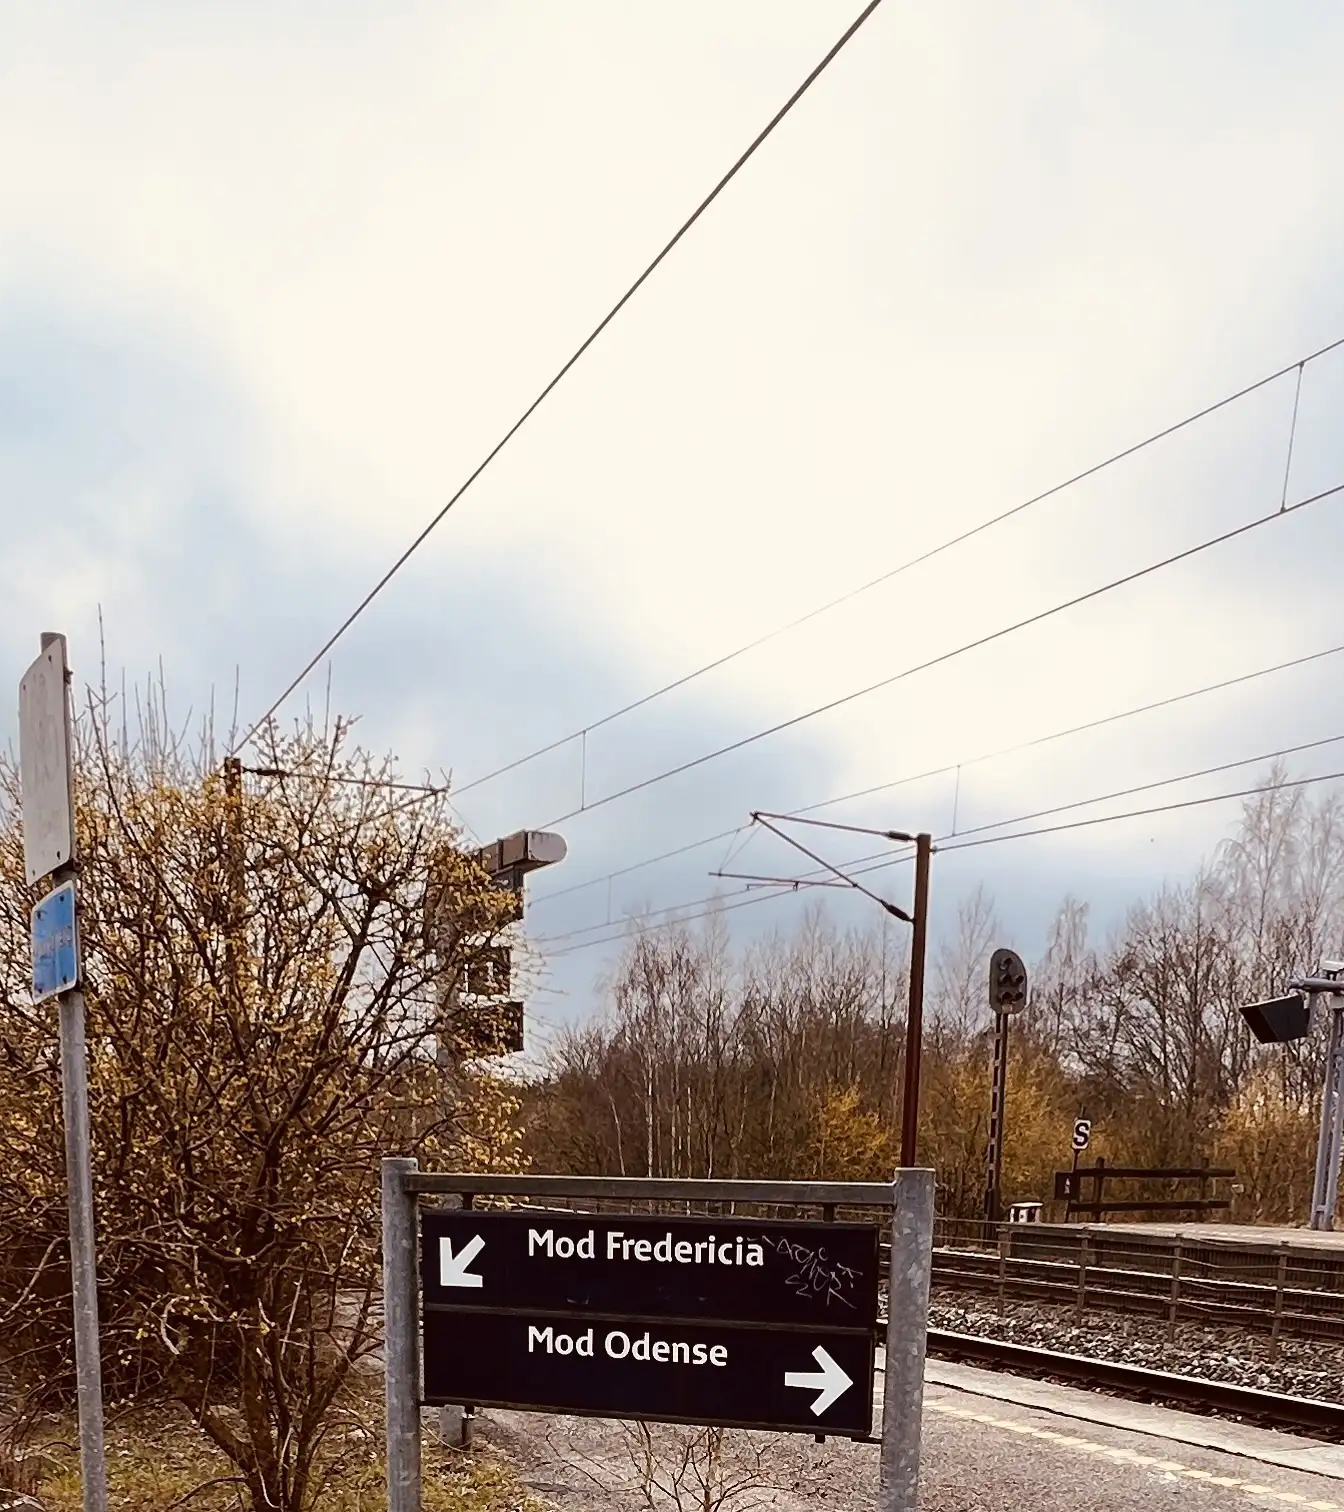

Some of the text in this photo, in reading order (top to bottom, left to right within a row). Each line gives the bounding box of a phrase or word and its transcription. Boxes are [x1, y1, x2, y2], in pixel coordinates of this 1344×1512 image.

[1073, 1122, 1090, 1146] S
[528, 1228, 764, 1267] Mod Fredericia
[528, 1325, 728, 1367] Mod Odense
